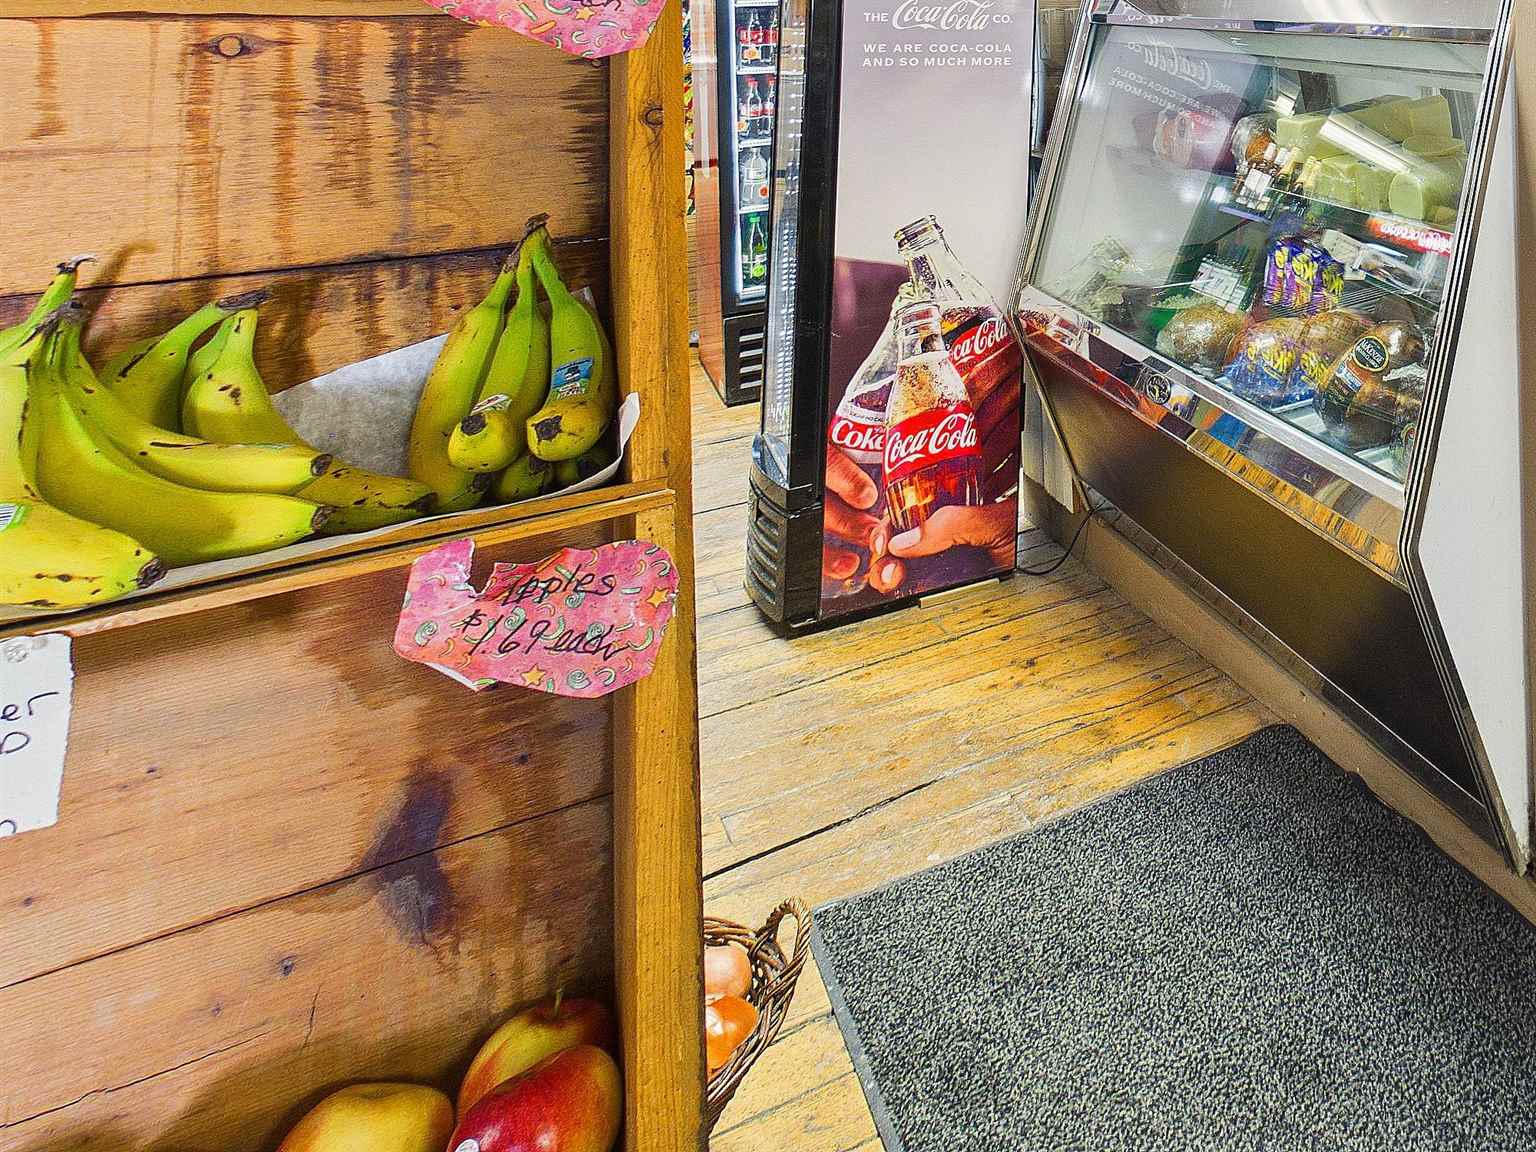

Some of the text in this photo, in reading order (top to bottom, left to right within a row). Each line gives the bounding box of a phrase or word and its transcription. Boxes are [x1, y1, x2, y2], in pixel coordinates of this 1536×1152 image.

[864, 12, 889, 22] THE
[992, 14, 1014, 24] CO.
[863, 43, 1012, 53] WE ARE COCA-COLA
[862, 56, 1013, 67] AND SO MUCH MORE
[885, 412, 977, 475] Coca-Cola
